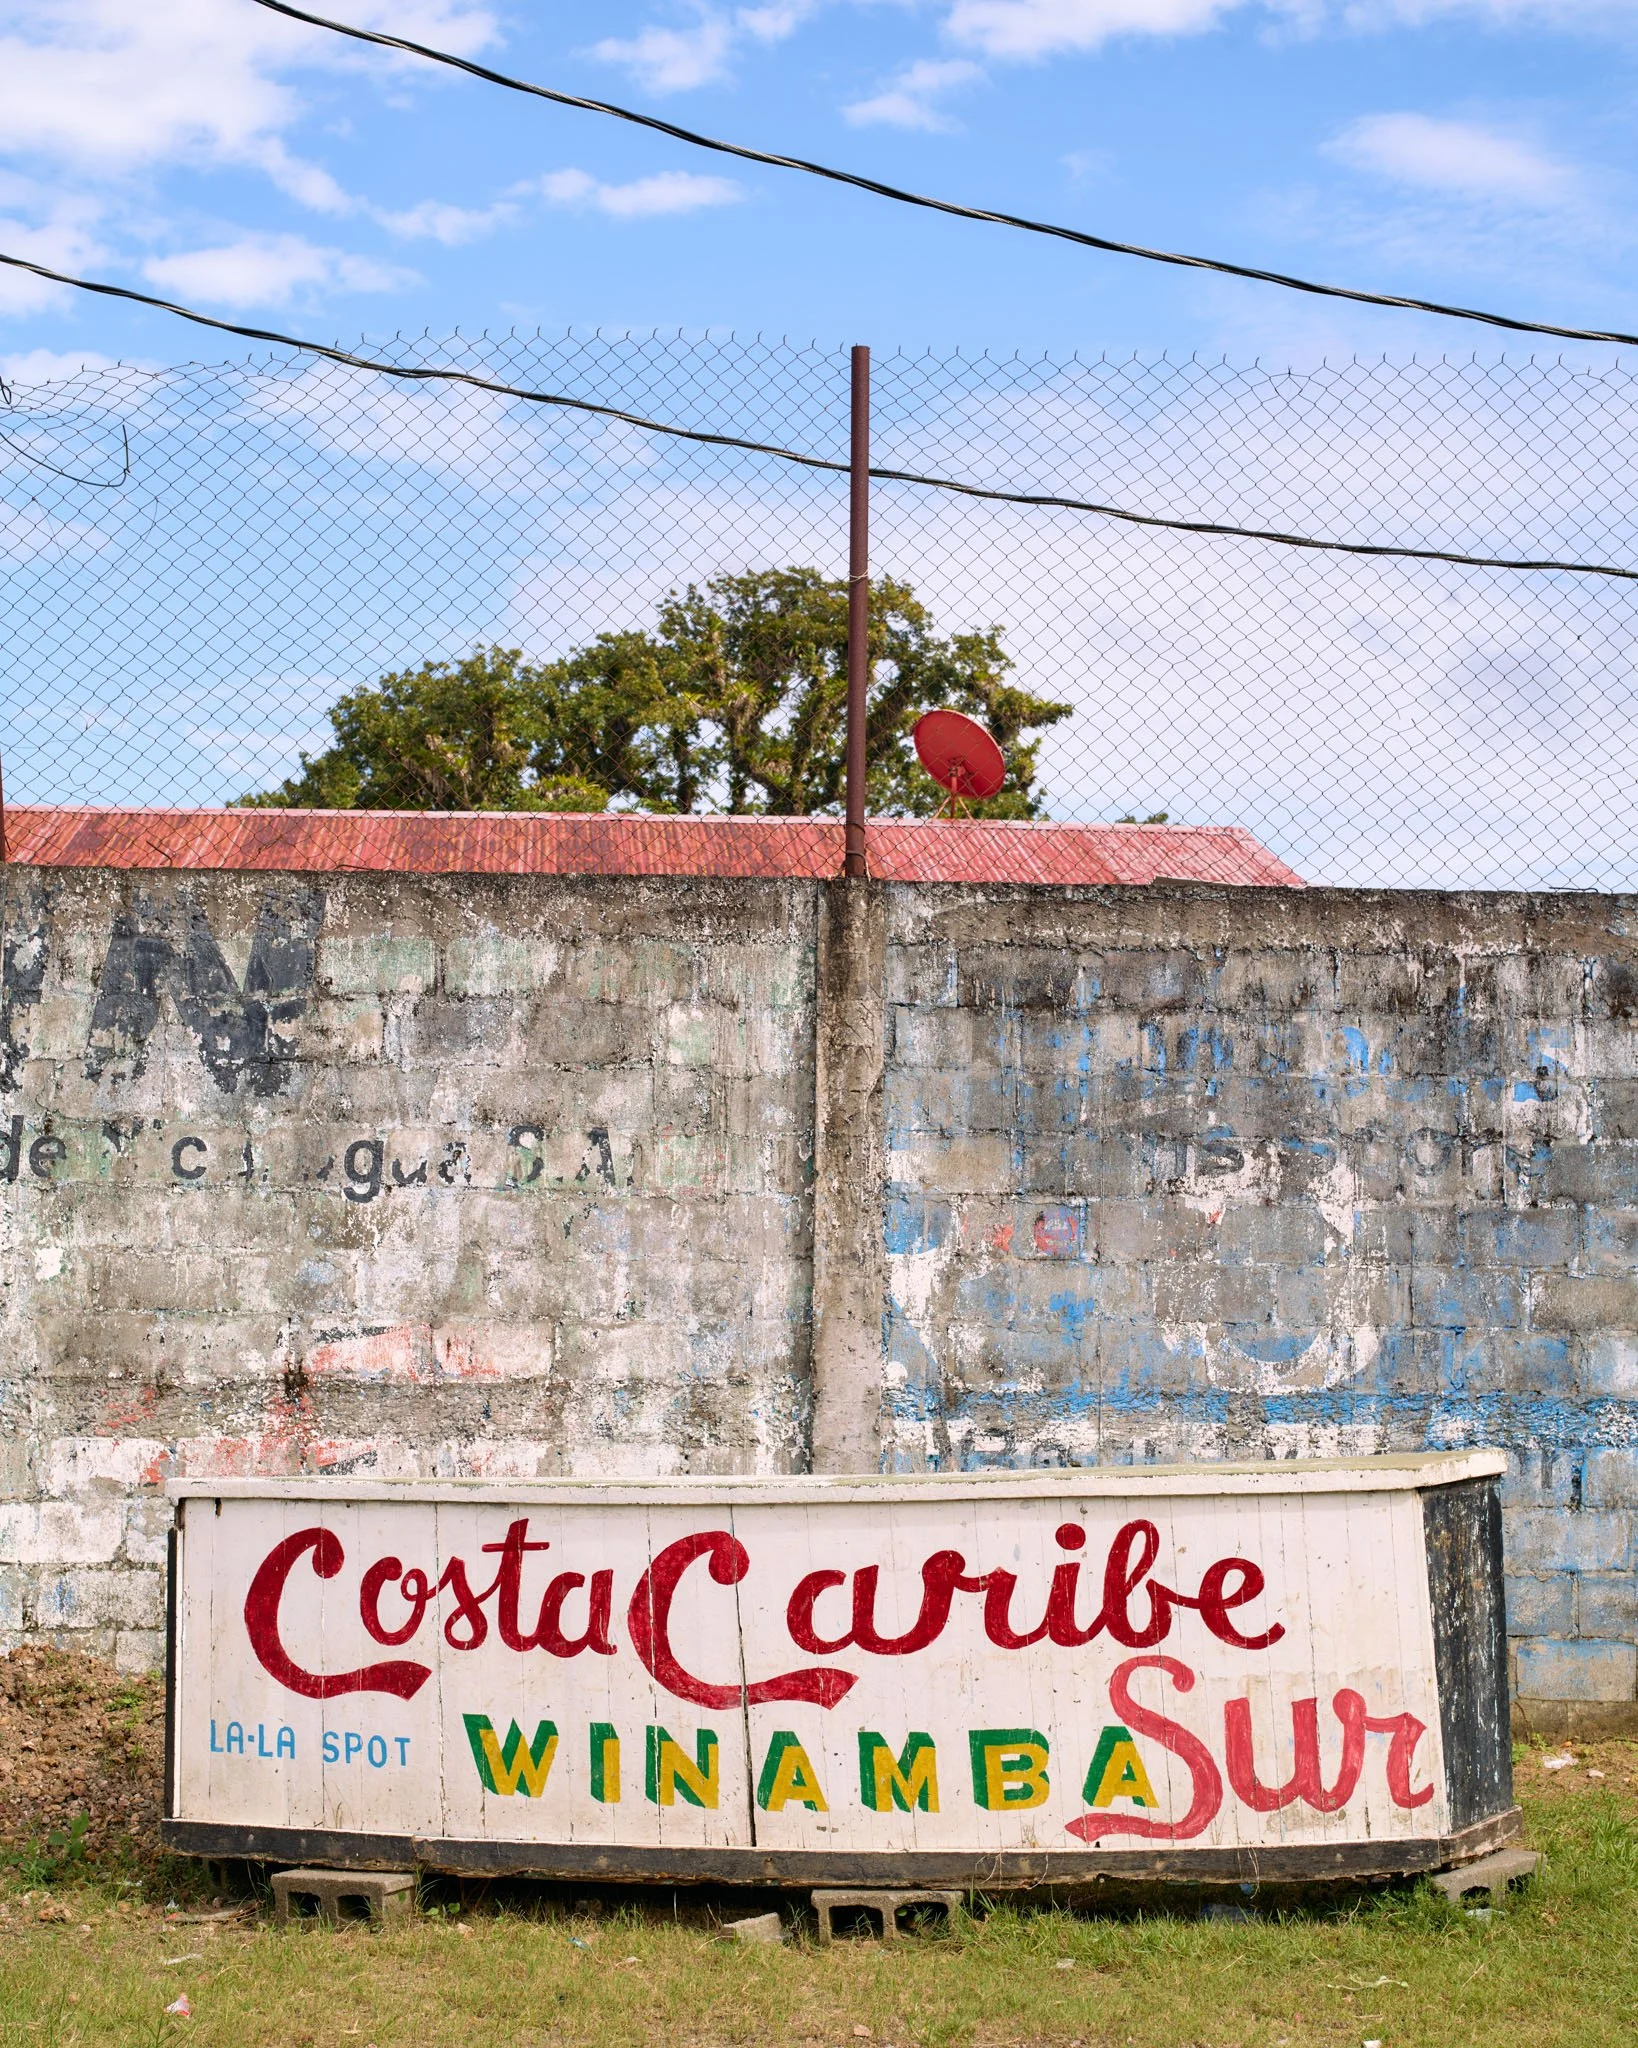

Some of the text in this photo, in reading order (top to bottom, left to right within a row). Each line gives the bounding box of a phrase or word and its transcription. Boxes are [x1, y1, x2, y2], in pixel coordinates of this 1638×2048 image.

[244, 1518, 1286, 1711] Costa Caribe
[322, 1731, 411, 1768] SPOT
[463, 1713, 1159, 1813] WINAMBA
[1064, 1655, 1435, 1842] Sur
